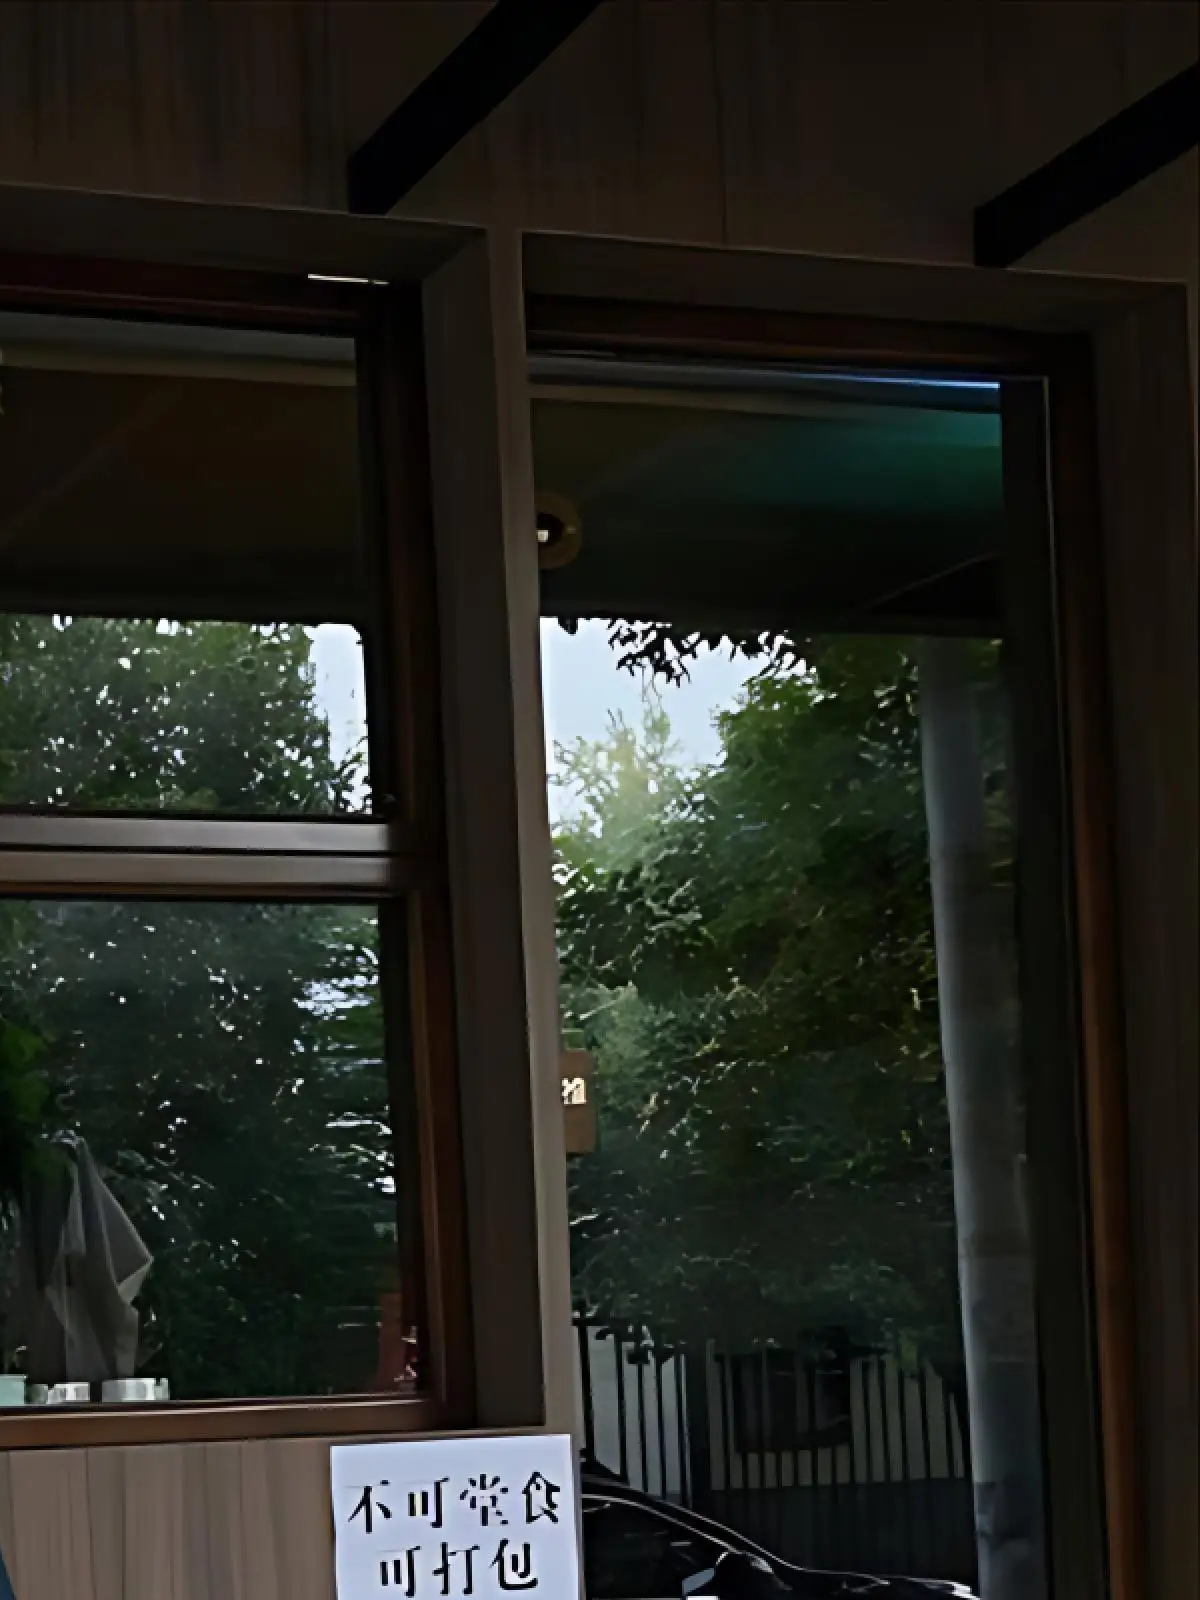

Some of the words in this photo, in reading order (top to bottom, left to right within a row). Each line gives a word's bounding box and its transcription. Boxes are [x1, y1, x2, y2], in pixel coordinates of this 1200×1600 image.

[347, 1471, 561, 1534] 不可堂食
[377, 1538, 539, 1598] 可打包
